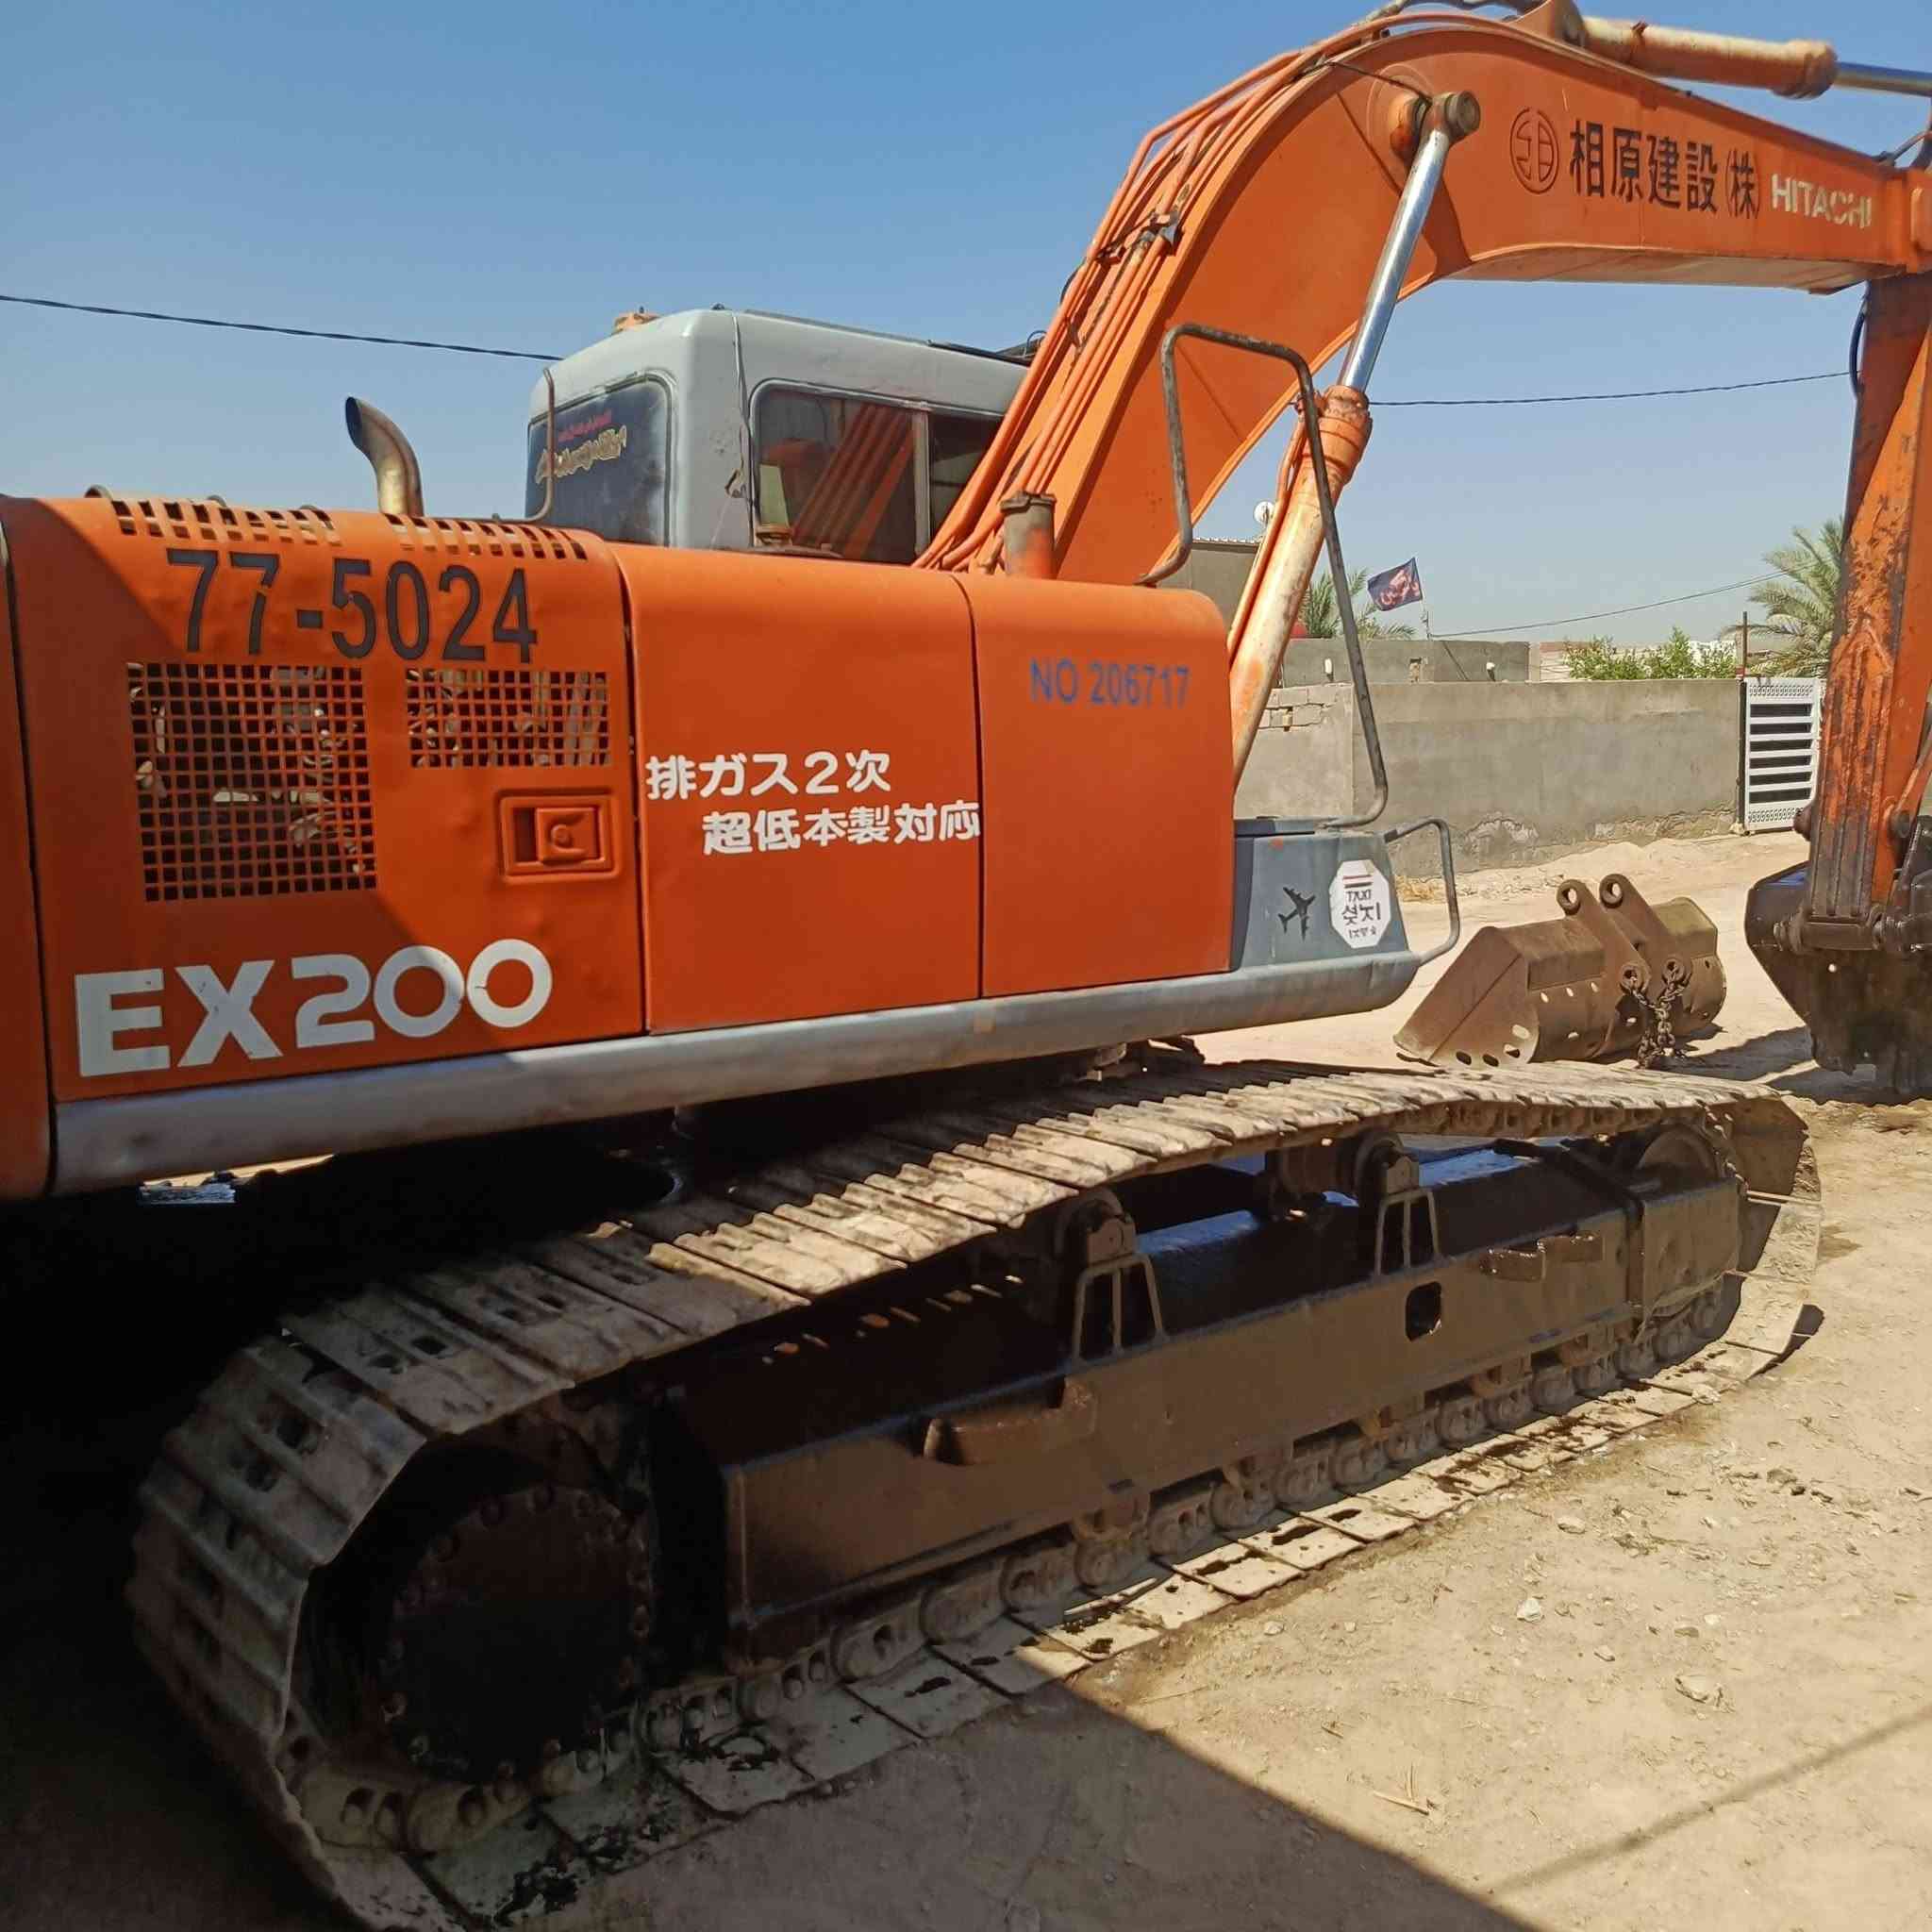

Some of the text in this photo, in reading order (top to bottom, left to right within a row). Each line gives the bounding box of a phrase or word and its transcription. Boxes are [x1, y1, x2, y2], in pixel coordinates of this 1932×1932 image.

[1771, 174, 1872, 228] HITACHI
[167, 548, 537, 663] 77-5024
[1030, 659, 1190, 708] NO 206717
[75, 940, 552, 1076] EX200
